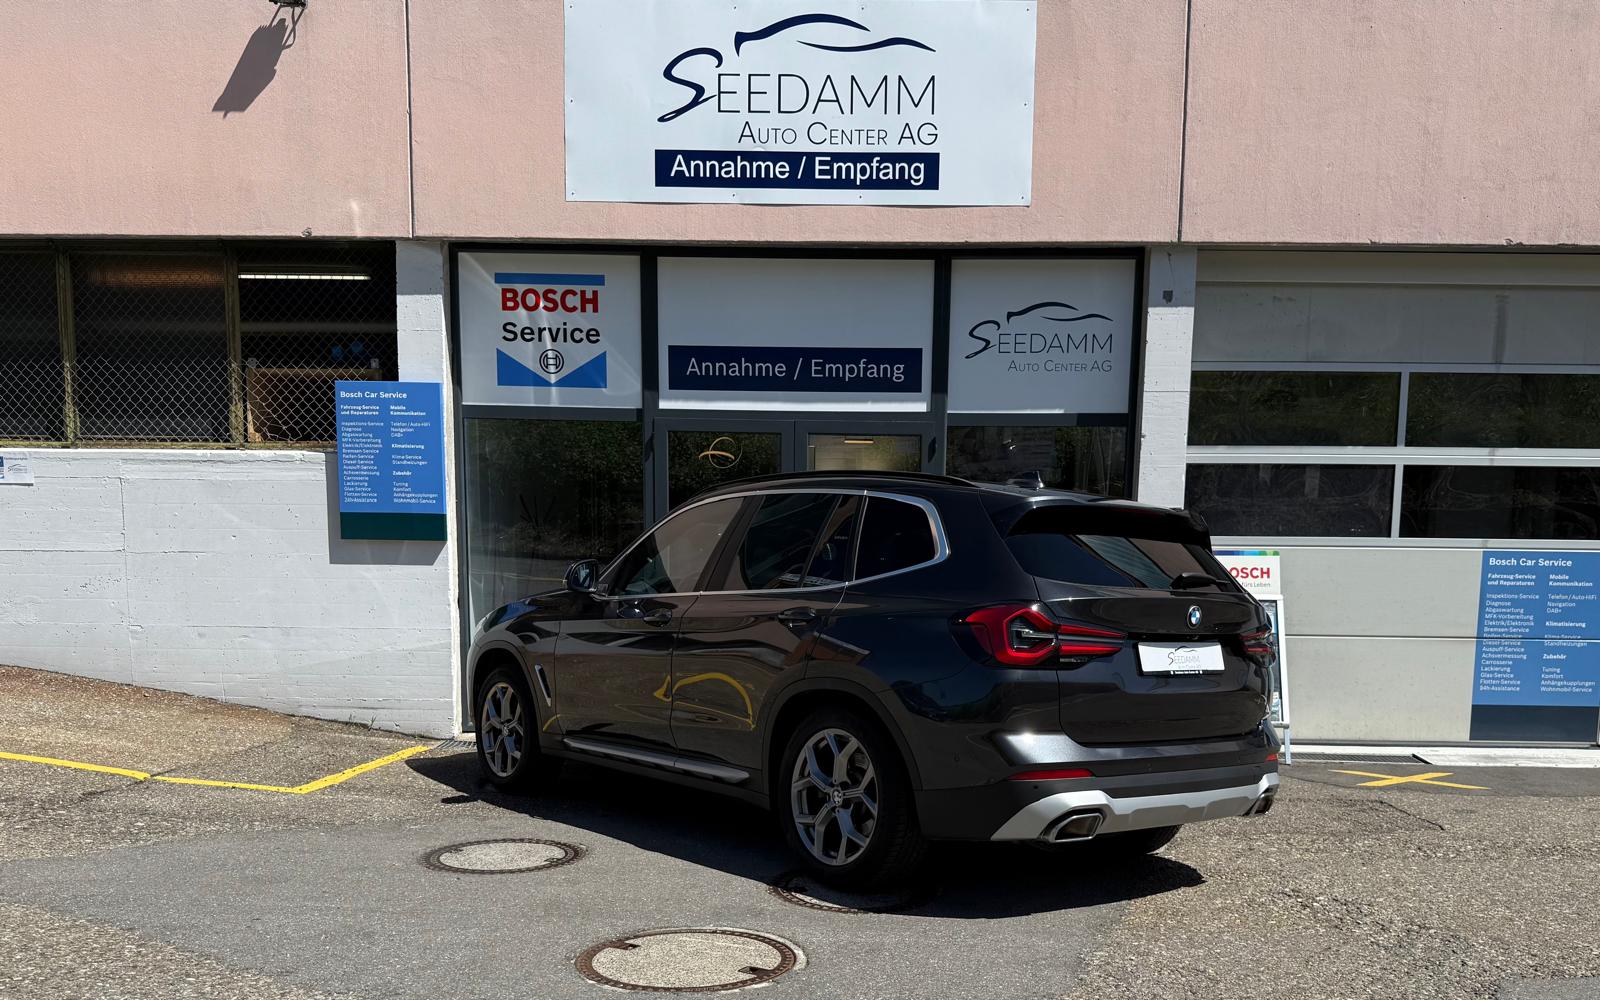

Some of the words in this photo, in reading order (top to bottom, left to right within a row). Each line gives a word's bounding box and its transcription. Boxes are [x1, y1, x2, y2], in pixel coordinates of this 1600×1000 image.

[897, 122, 939, 146] AG
[670, 155, 790, 179] Annahme
[797, 156, 807, 180] /
[814, 157, 925, 185] Empfang
[501, 288, 599, 313] BOSCH
[502, 321, 600, 345] Service
[686, 358, 786, 377] Annahme
[793, 358, 802, 380] /
[811, 359, 905, 381] Empfang
[1090, 360, 1112, 372] AG
[1229, 567, 1270, 578] OSCH
[1489, 558, 1516, 566] Bosch
[1520, 558, 1536, 566] Car
[1538, 558, 1572, 567] Service
